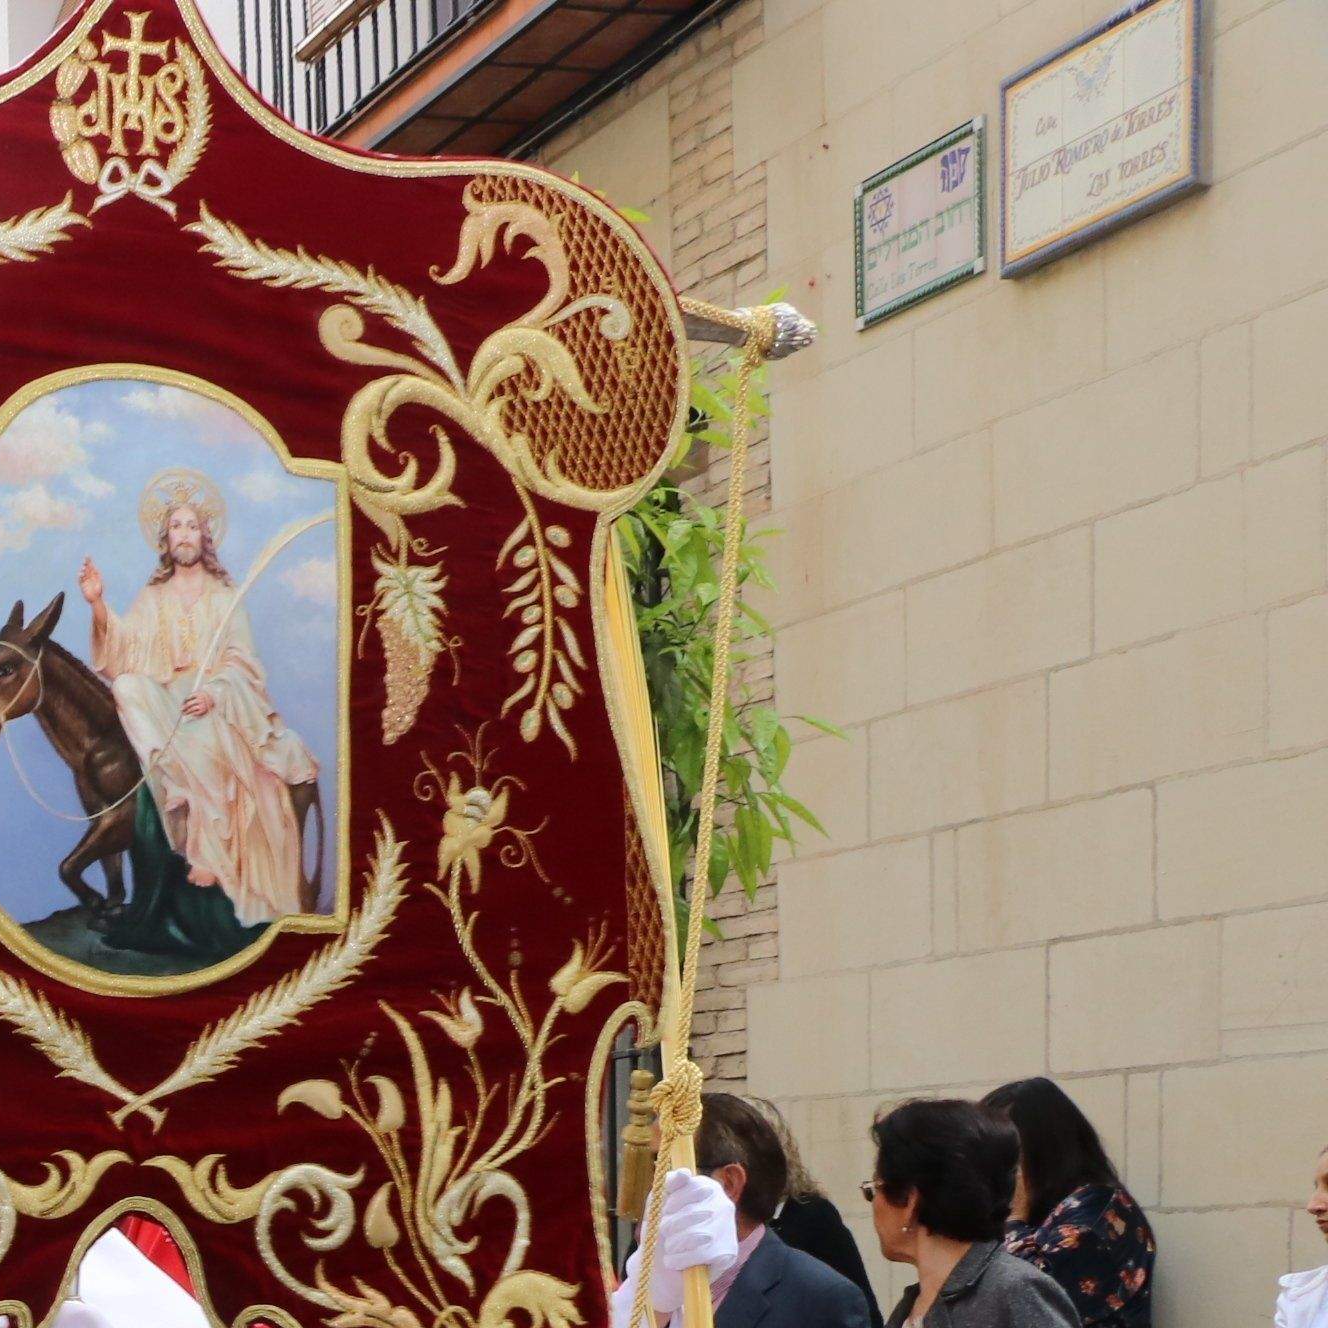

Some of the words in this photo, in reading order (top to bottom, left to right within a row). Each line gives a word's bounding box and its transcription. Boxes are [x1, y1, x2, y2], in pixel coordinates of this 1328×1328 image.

[1015, 165, 1050, 200] JULIO
[1053, 129, 1109, 175] ROMERO
[1123, 93, 1176, 138] TORRES
[1118, 139, 1168, 180] TORRES
